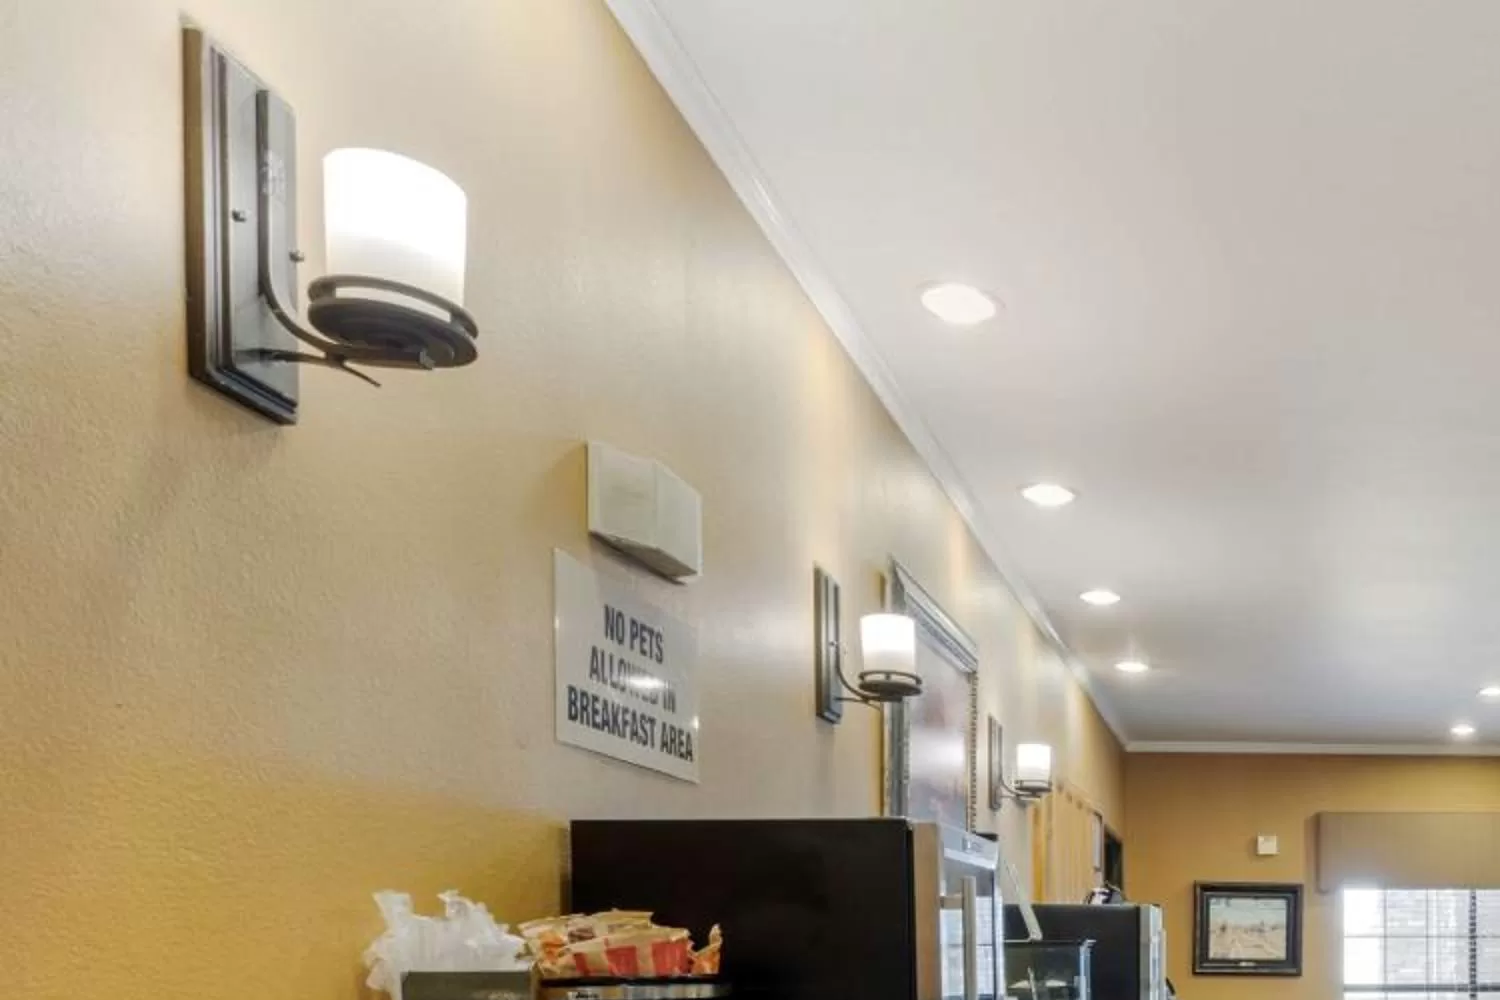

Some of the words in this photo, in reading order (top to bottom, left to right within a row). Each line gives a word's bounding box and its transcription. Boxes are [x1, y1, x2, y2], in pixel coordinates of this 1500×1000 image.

[604, 604, 625, 646] NO
[629, 617, 664, 665] PETS
[567, 684, 657, 749] BREAKFAST
[659, 721, 694, 762] AREA
